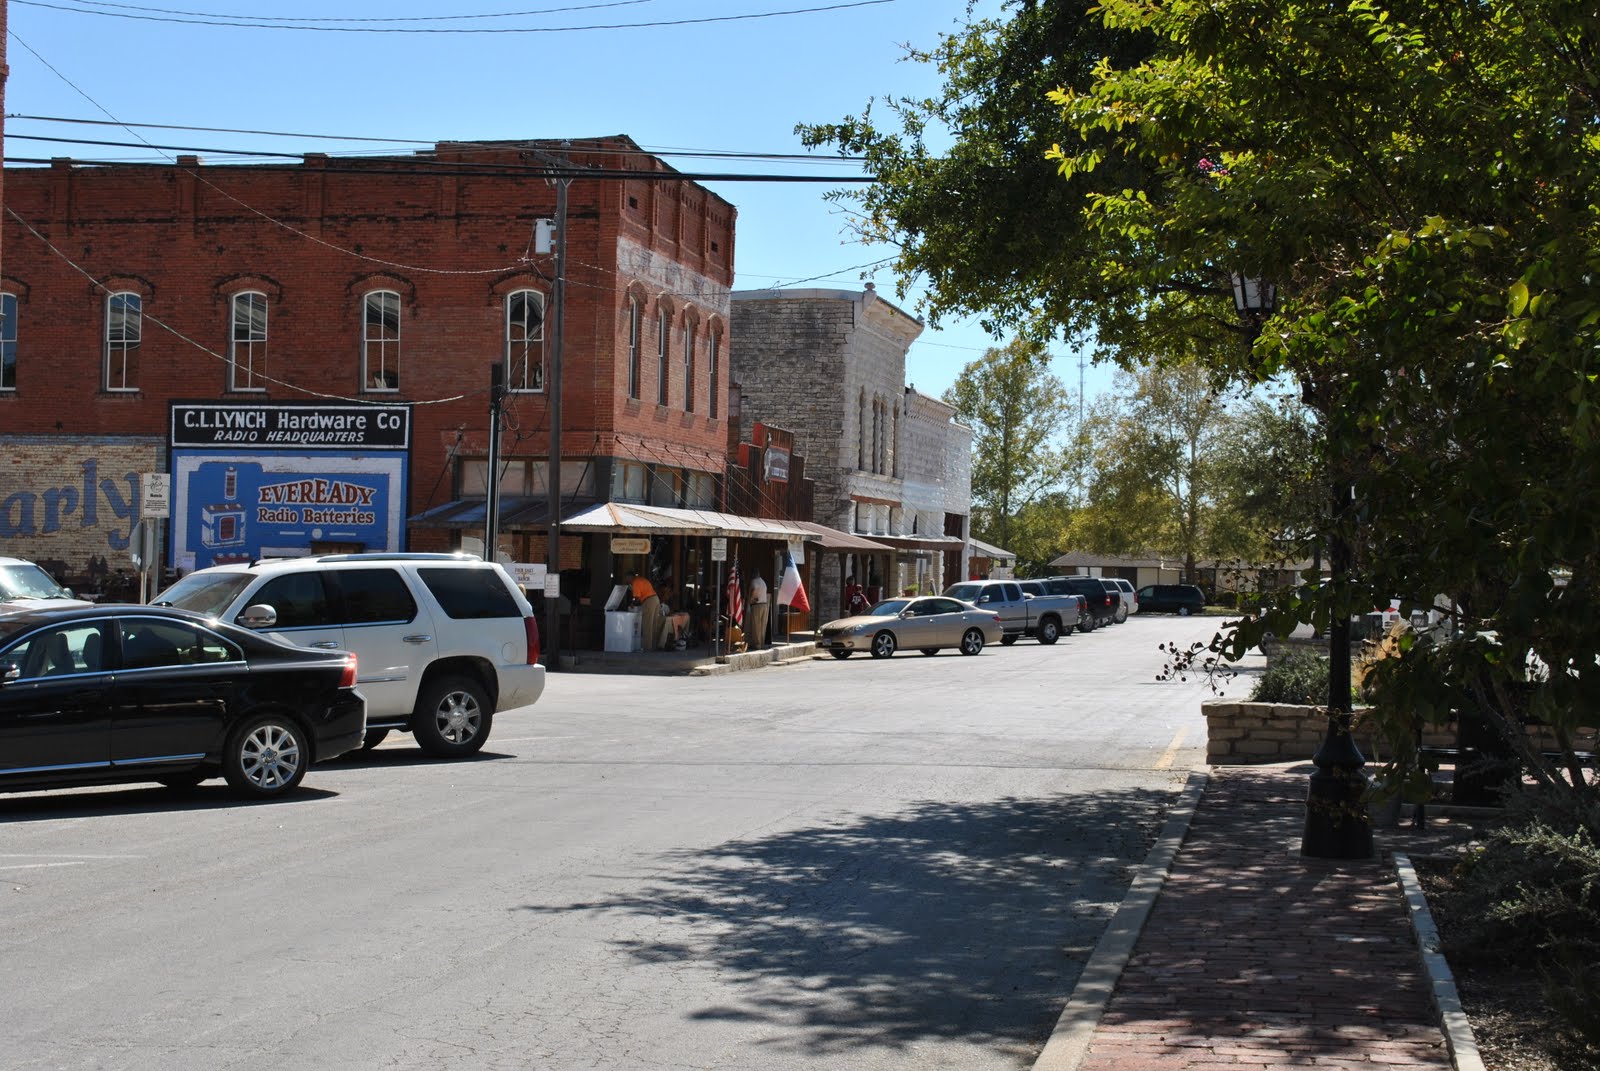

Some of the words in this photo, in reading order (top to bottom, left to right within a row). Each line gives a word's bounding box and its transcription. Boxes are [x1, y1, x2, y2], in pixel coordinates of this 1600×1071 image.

[278, 412, 367, 429] Hardware
[377, 412, 401, 430] Co
[213, 431, 258, 441] RADIO
[265, 431, 365, 444] HEADQUARTERS
[258, 478, 377, 505] EVEREADY
[257, 507, 298, 524] Radio
[302, 507, 375, 525] Batteries
